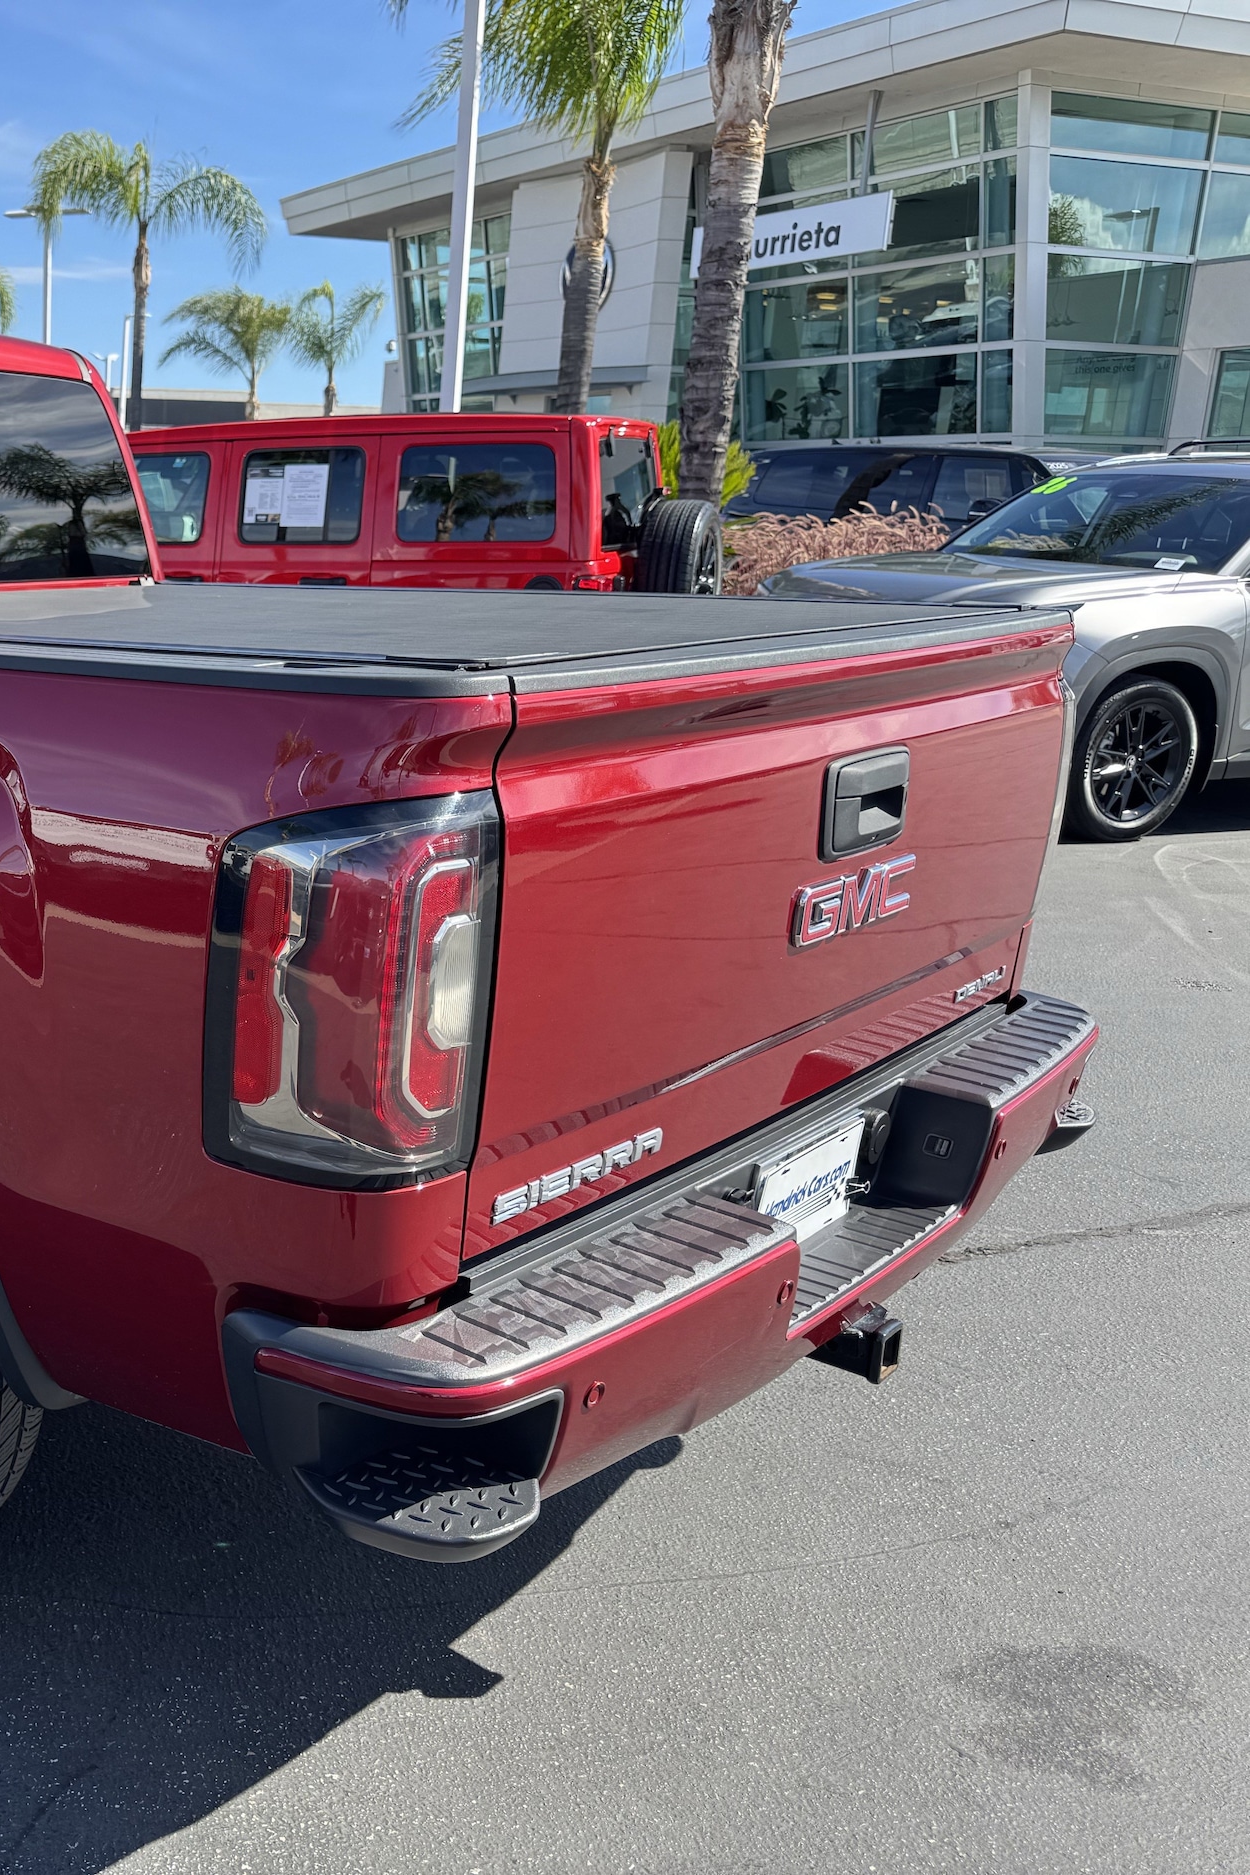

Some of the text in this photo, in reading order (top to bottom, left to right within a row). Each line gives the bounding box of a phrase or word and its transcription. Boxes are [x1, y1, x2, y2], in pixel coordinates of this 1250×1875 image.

[749, 222, 841, 259] urrieta
[789, 853, 917, 948] GMC
[953, 965, 1007, 1004] DENALI
[491, 1127, 664, 1227] SIERRA
